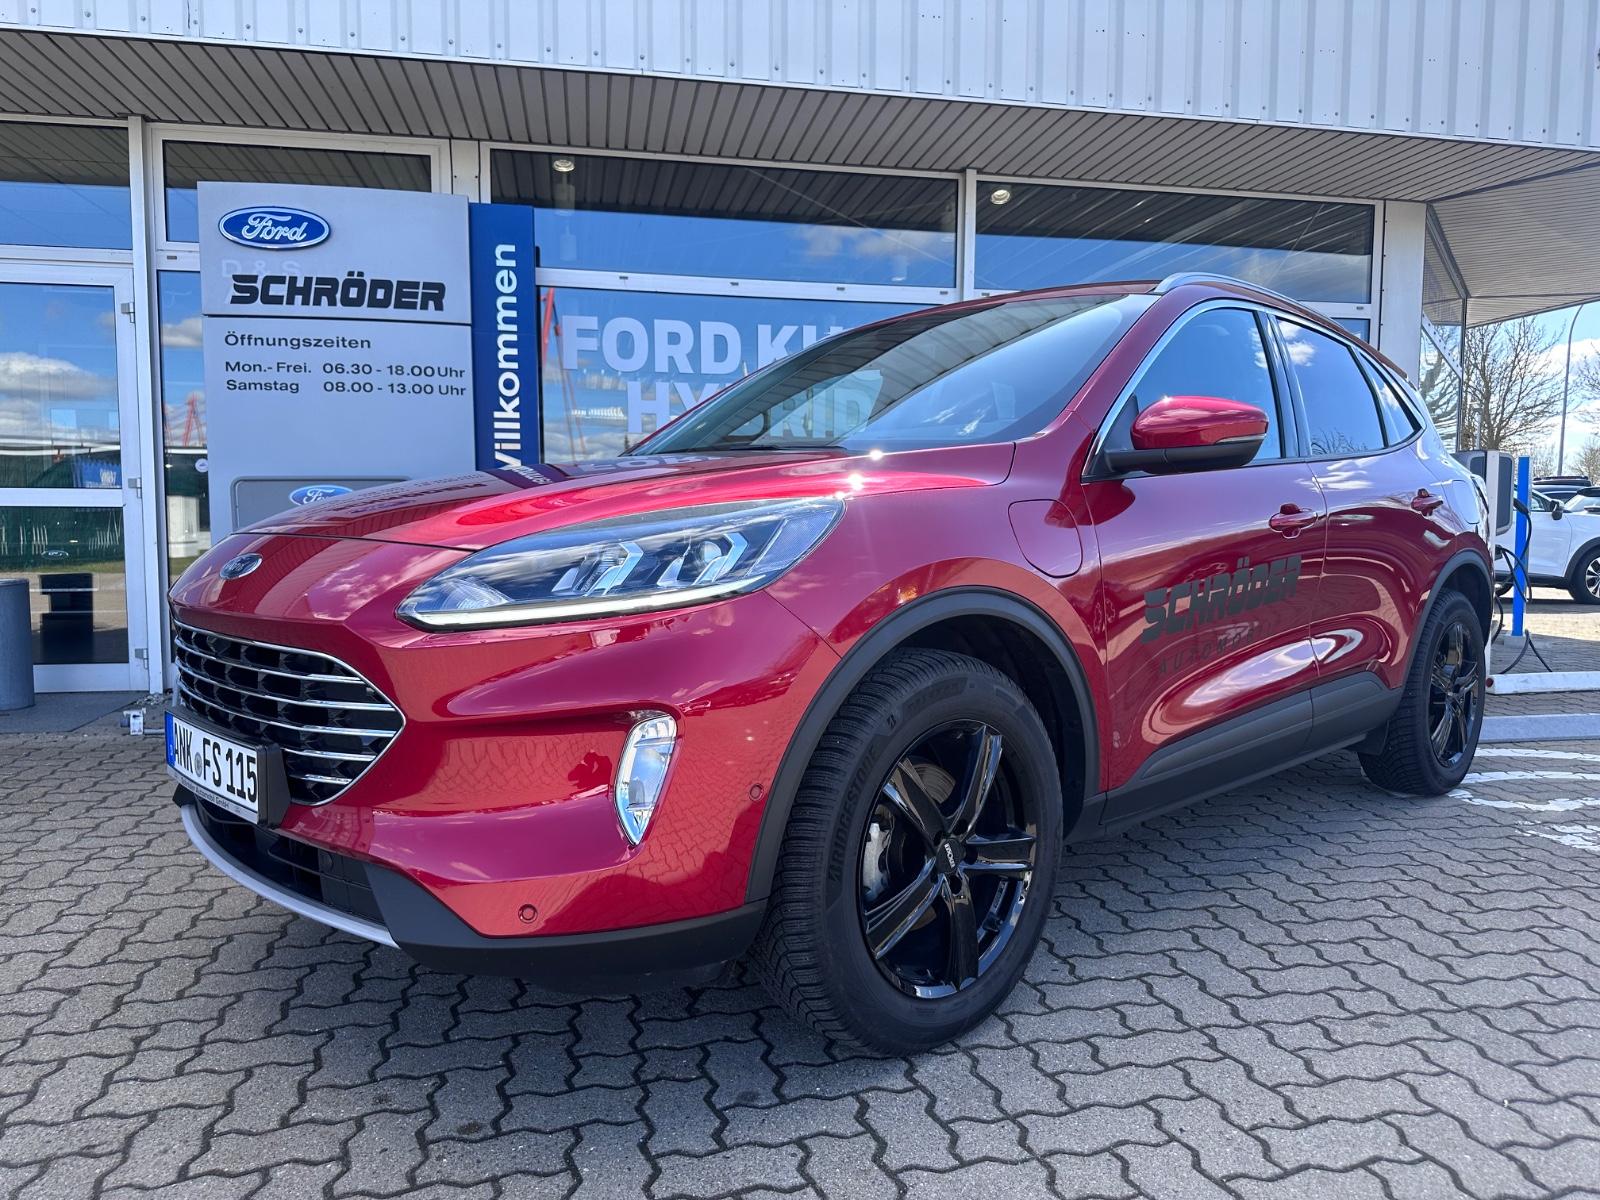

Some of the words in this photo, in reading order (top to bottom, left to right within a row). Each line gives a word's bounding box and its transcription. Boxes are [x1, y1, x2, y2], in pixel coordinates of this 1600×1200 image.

[242, 213, 308, 241] Ford
[230, 270, 447, 312] SCHRÖDER
[224, 331, 372, 350] Öffnungszeiten
[561, 315, 742, 375] FORD
[226, 379, 300, 394] Samstag
[323, 381, 374, 393] 08.00
[389, 383, 434, 395] 13.00
[439, 385, 467, 397] Uhr
[322, 363, 372, 375] 06.30
[387, 365, 436, 377] 18.00
[437, 366, 466, 379] Uhr
[1141, 555, 1302, 644] SCHRÖDER
[174, 722, 194, 774] ANK
[226, 748, 258, 803] 115
